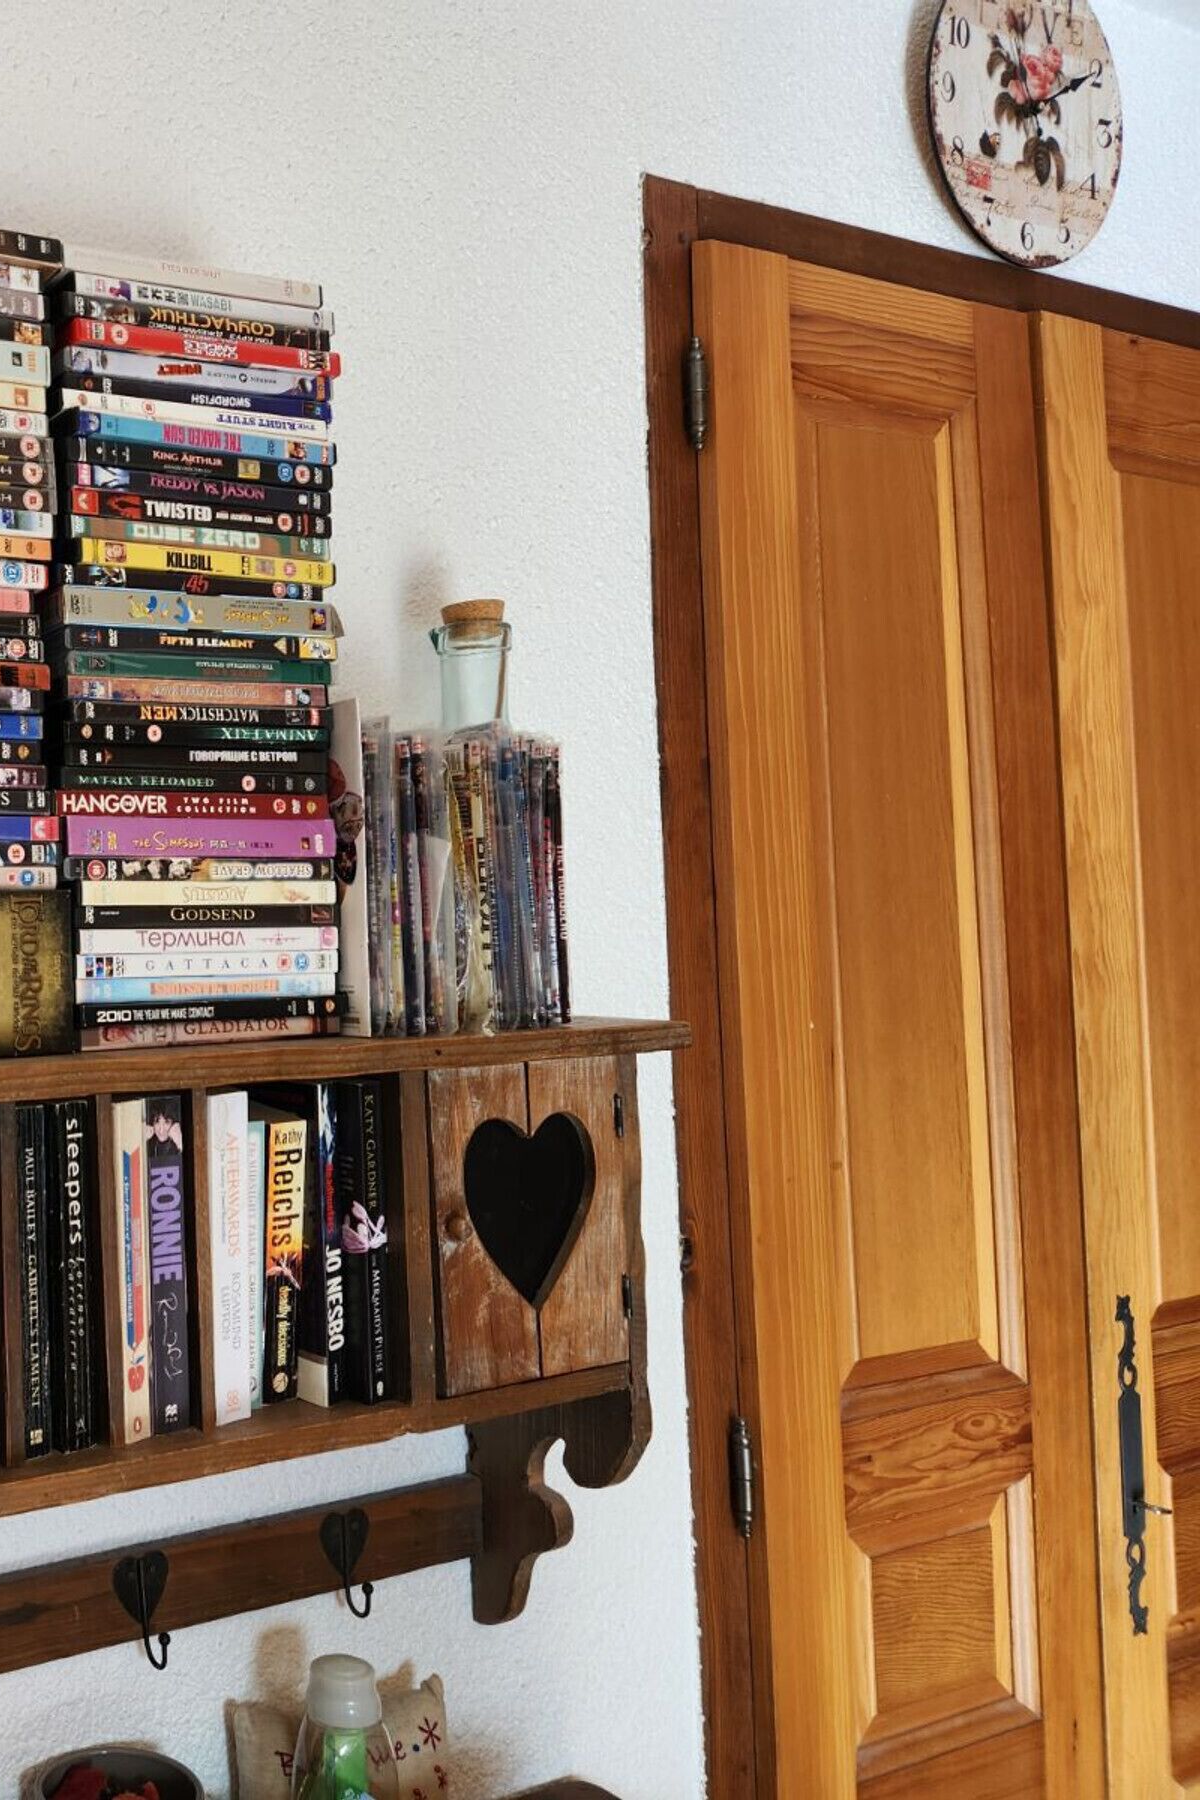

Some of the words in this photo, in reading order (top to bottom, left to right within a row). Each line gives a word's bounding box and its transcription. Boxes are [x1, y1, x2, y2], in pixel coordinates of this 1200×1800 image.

[948, 16, 970, 49] 10
[941, 71, 955, 103] 9
[1096, 119, 1112, 149] 3
[1080, 173, 1099, 201] 4
[983, 195, 995, 227] 7
[1021, 222, 1034, 251] 6
[148, 306, 275, 337] СОУЧАСТНИК
[190, 394, 251, 408] SWORDFISH
[162, 423, 185, 444] GUN
[188, 430, 220, 450] NAKED
[223, 433, 242, 452] THE
[153, 450, 178, 460] KING
[181, 452, 223, 466] ARTHUR
[144, 499, 213, 522] TWISTED
[160, 632, 194, 647] FIFTH
[197, 636, 256, 650] ELEMENT
[140, 706, 178, 721] MEN
[178, 707, 259, 723] MATCHSTICK
[220, 727, 319, 741] ANIMATRIX
[79, 776, 133, 786] MATRIX
[141, 776, 216, 788] RELOADED
[62, 794, 168, 814] HANGOVER
[212, 864, 252, 879] GRAVE
[257, 864, 312, 879] SHALLOW
[170, 907, 256, 921] GODSEND
[136, 930, 246, 951] Терминал
[145, 957, 268, 972] GATTACA
[96, 1010, 132, 1022] 2010
[133, 1009, 145, 1022] THE
[146, 1009, 160, 1021] YEAR
[161, 1008, 173, 1020] WE
[173, 1008, 187, 1019] MAKE
[188, 1006, 215, 1019] CONTACT
[184, 1018, 289, 1036] GLADIATOR
[363, 1094, 374, 1134] KATY
[274, 1129, 303, 1145] Kathy
[25, 1147, 36, 1183] PAUL
[365, 1139, 376, 1209] GARDNER
[65, 1118, 84, 1245] sleepers
[226, 1133, 241, 1258] AFTERWARDS
[271, 1147, 303, 1248] Reichs
[25, 1192, 37, 1241] BAILEY
[150, 1165, 182, 1285] RONNIE
[325, 1245, 341, 1274] JO
[27, 1254, 40, 1337] GABRIEL'S
[326, 1276, 344, 1352] NESBO
[30, 1342, 41, 1409] LAMENT
